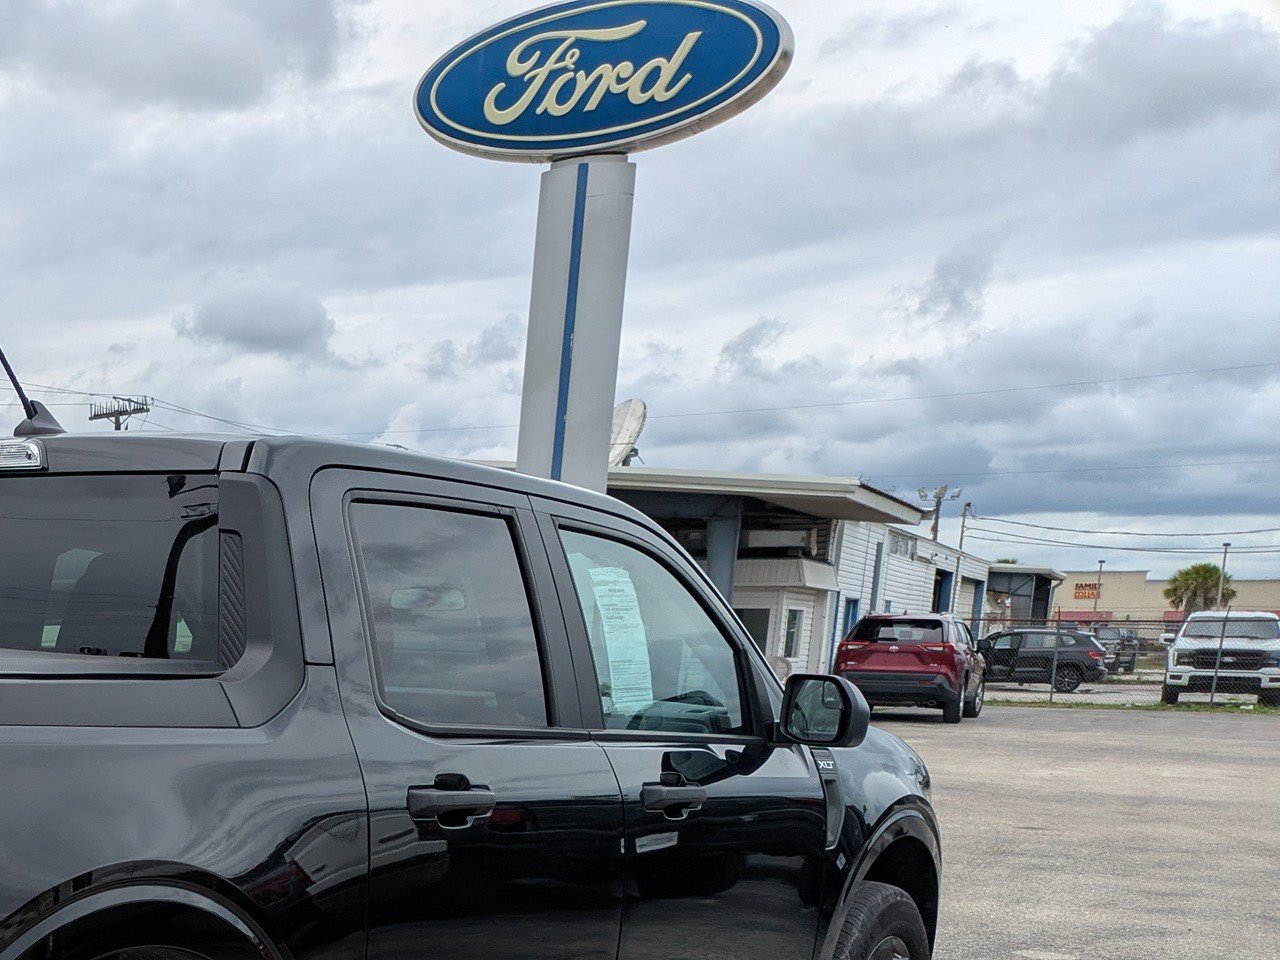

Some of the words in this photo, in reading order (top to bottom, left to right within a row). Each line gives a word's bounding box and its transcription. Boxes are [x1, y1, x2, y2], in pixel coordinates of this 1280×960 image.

[483, 19, 703, 126] Ford
[1075, 583, 1102, 591] FAMILY
[817, 760, 835, 769] XLT
